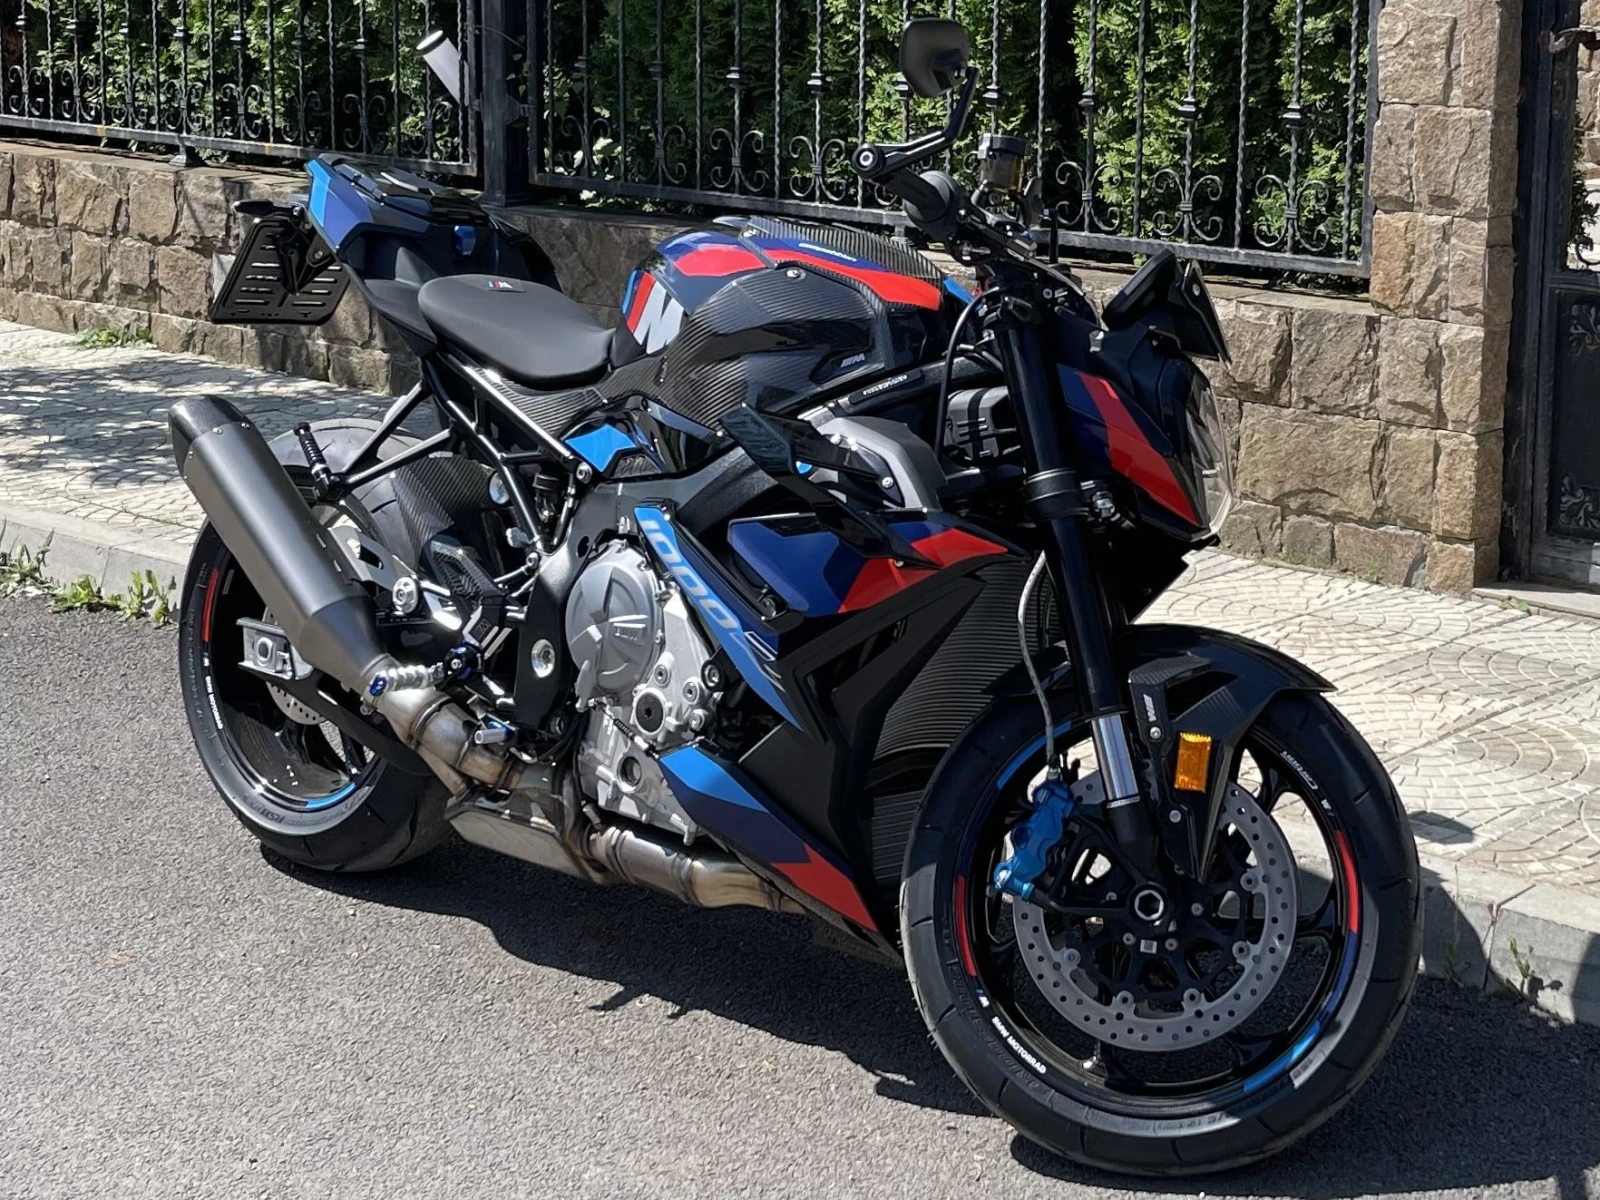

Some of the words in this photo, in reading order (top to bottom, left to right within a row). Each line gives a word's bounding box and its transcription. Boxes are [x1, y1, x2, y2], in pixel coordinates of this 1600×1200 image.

[639, 520, 741, 629] 1000
[991, 1016, 1010, 1038] BMW
[1006, 1035, 1047, 1074] MOTORRAD
